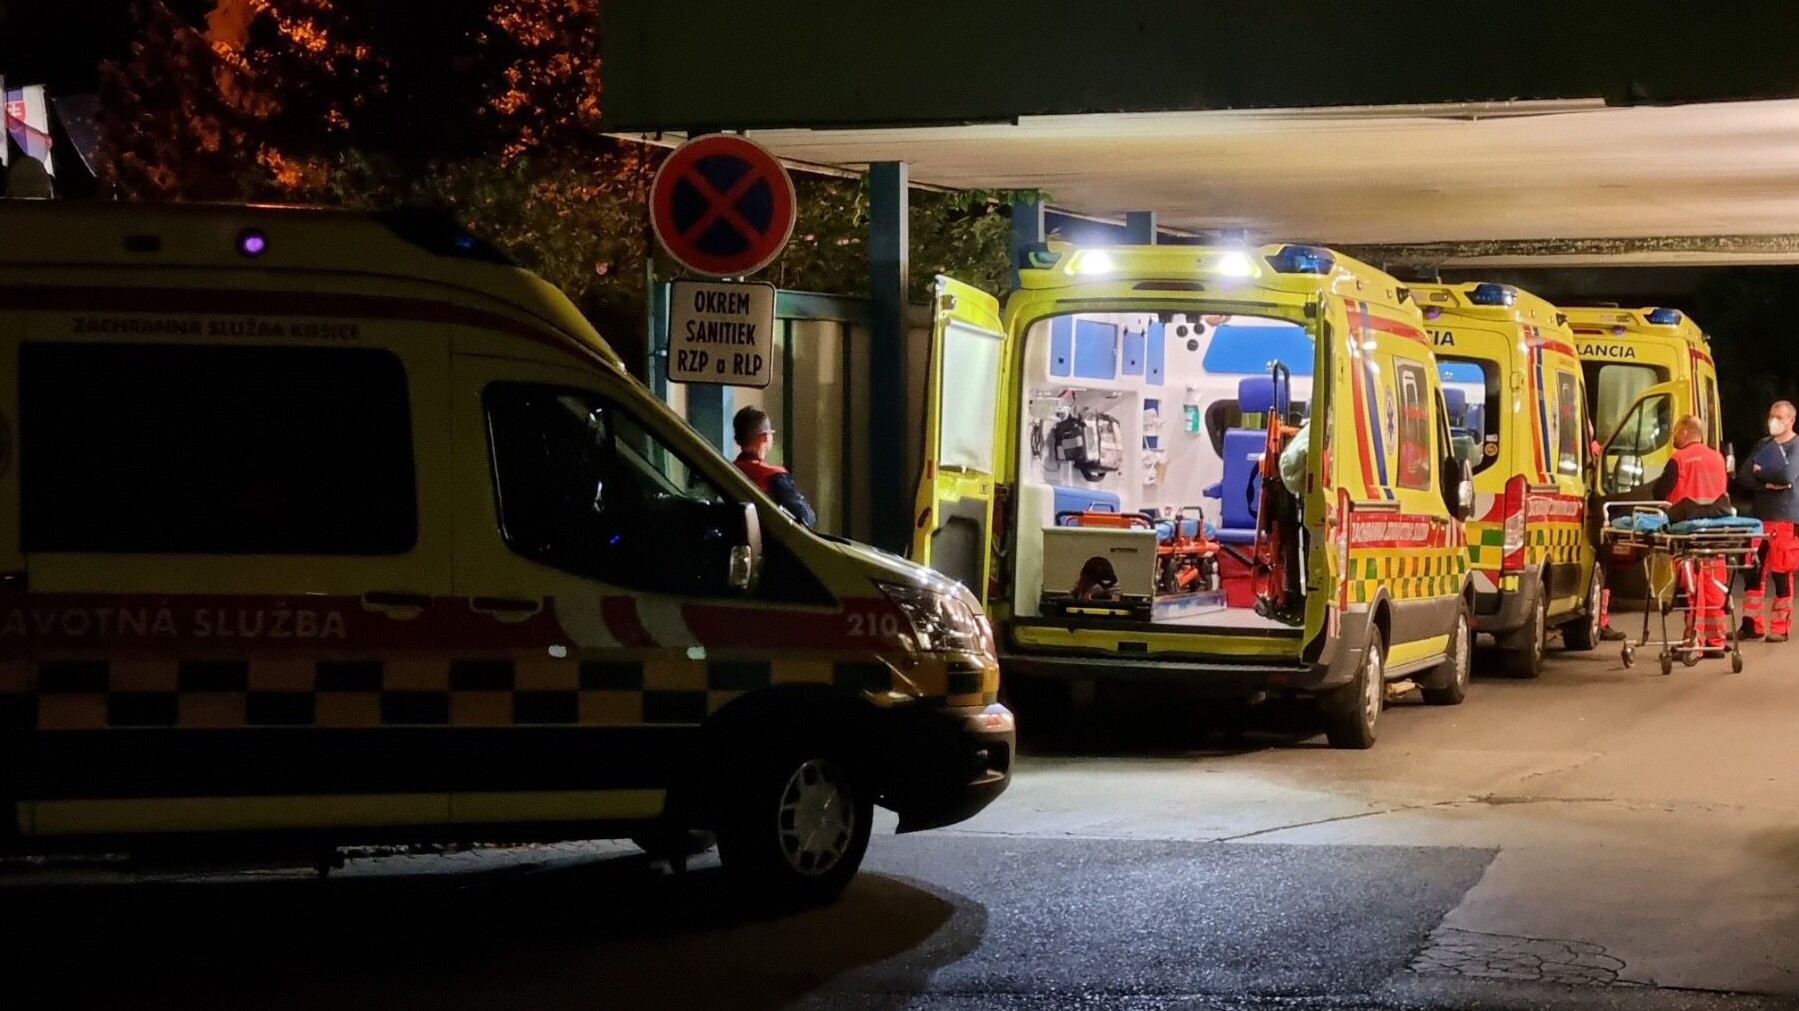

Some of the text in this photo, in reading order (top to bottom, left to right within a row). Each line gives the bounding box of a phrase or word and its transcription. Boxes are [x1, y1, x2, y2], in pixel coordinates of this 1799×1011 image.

[694, 290, 750, 315] OKREM
[686, 319, 756, 346] SANITIEK
[677, 349, 763, 376] RZP a RLP
[191, 599, 348, 639] SLUŽBA
[845, 612, 899, 637] 210
